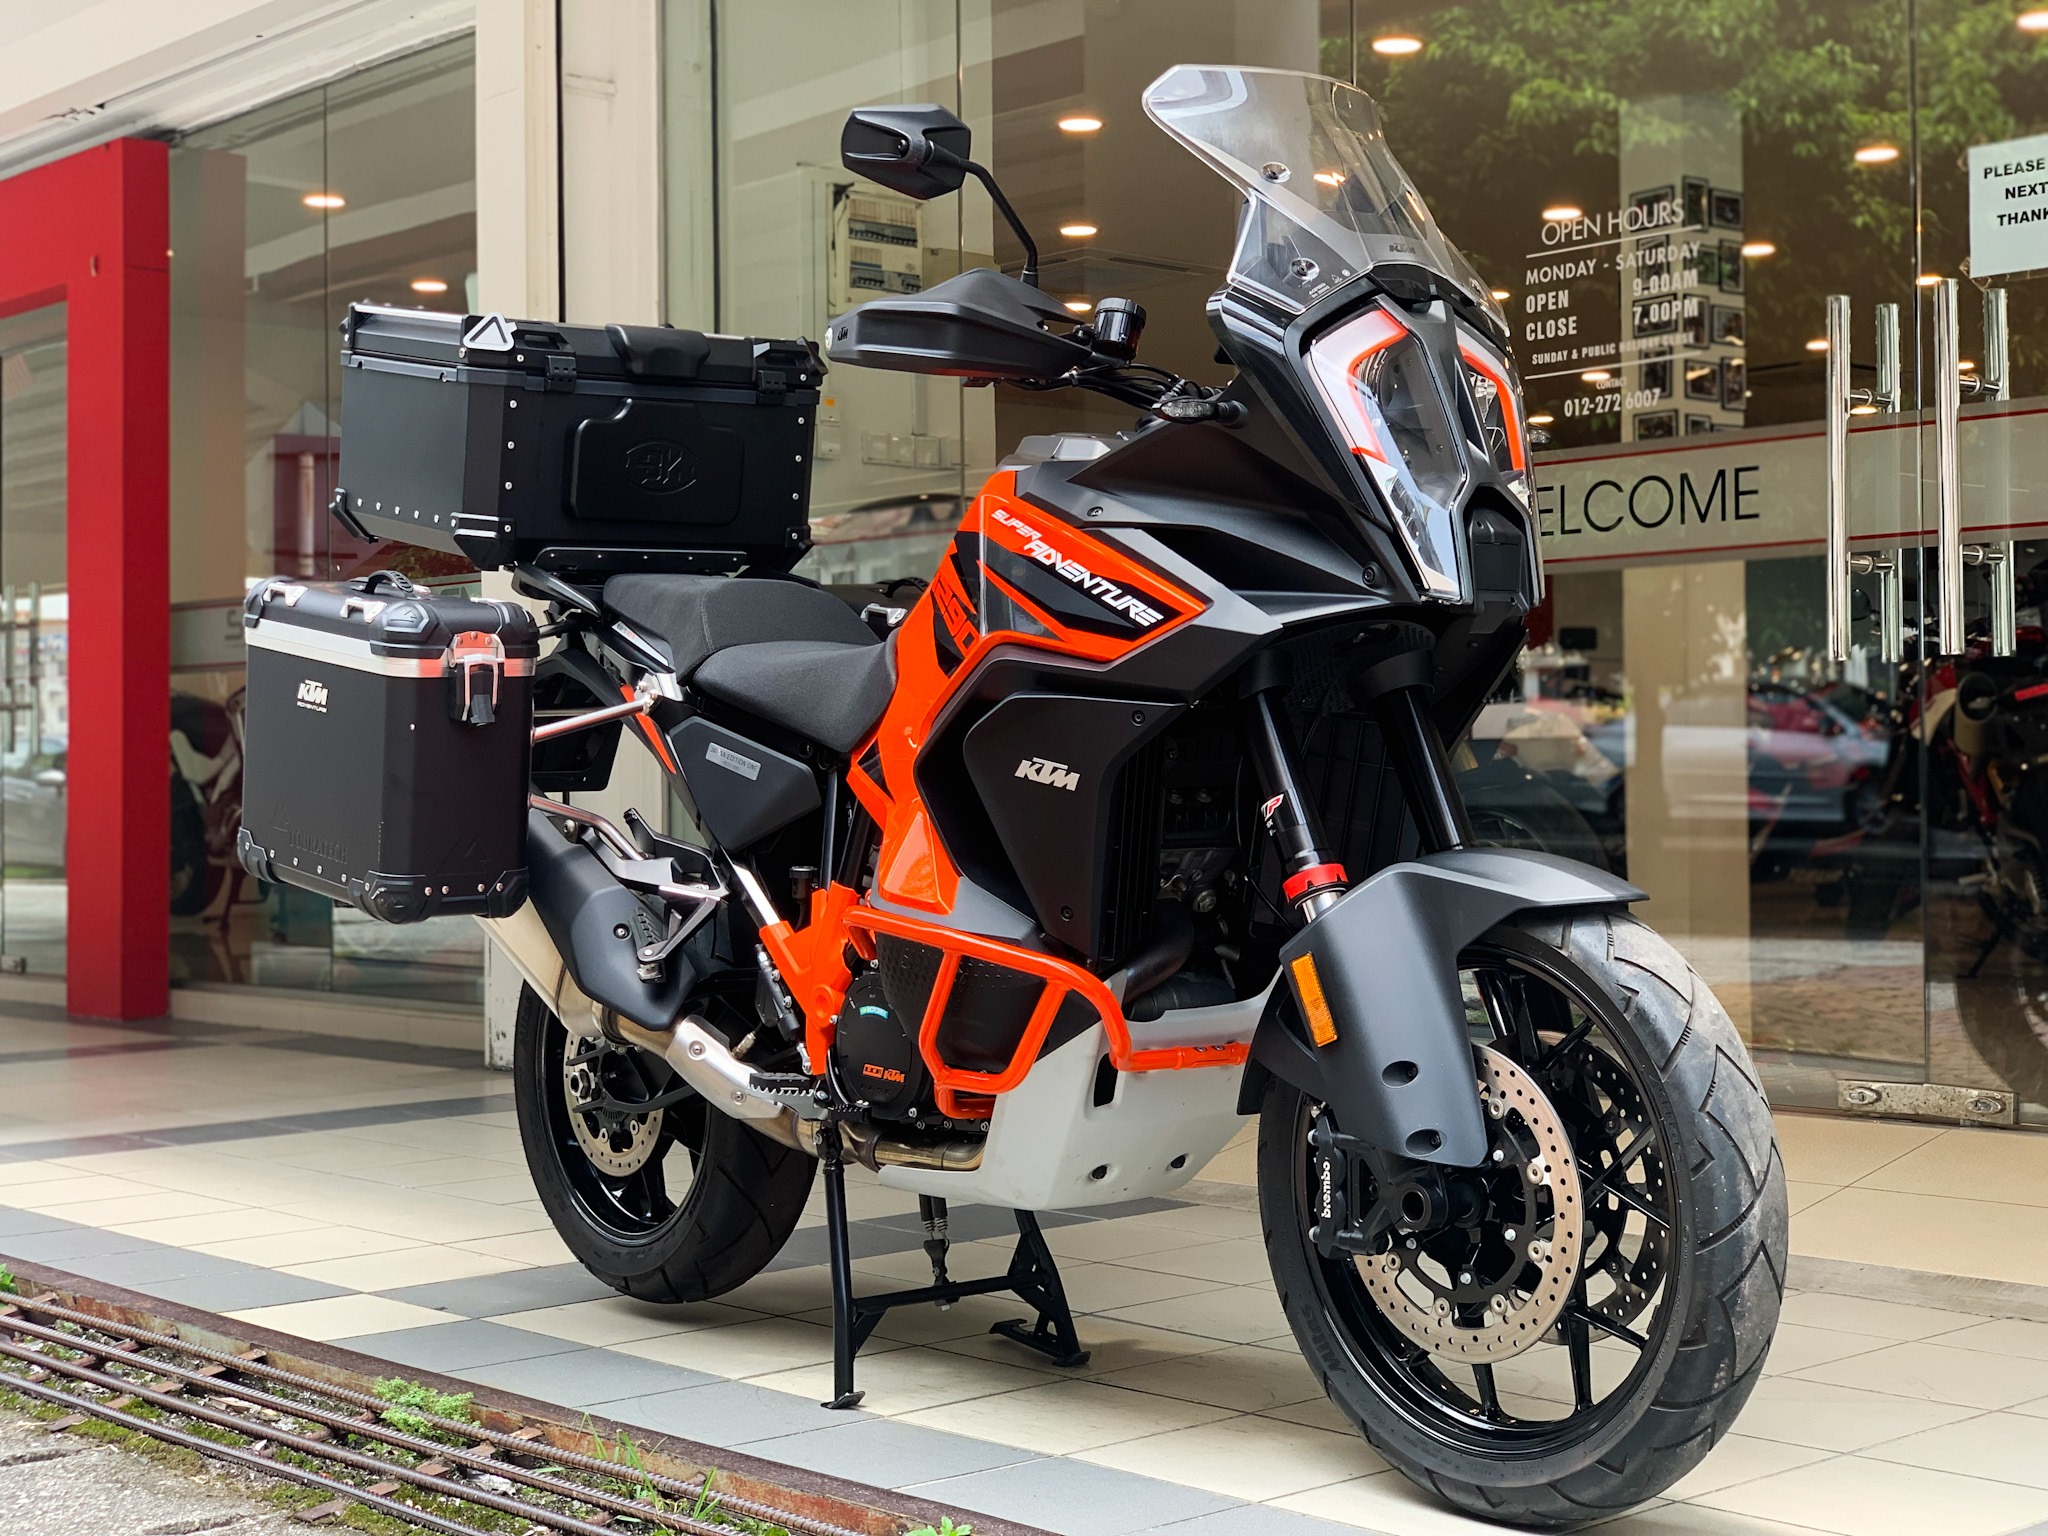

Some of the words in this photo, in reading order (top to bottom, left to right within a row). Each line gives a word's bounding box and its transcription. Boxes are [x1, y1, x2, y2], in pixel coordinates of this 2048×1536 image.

[1983, 157, 2046, 179] PLEASE
[1541, 213, 1601, 246] OPEN
[1608, 198, 1686, 234] HOURS
[1525, 258, 1597, 286] MONDAY
[1615, 241, 1701, 271] SATURDAY
[1525, 289, 1570, 314] OPEN
[1632, 269, 1699, 297] 9.00AM
[1525, 316, 1578, 342] CLOSE
[1632, 299, 1699, 326] 7.00PM
[1531, 348, 1569, 366] SUNDAY
[1571, 345, 1578, 360] &
[1581, 343, 1616, 359] PUBLIC
[1563, 393, 1621, 418] 012-272
[1625, 387, 1661, 410] 6007
[1536, 465, 1760, 537] ELCOME
[991, 508, 1043, 541] SUPER
[1023, 539, 1165, 628] ADVENTURE
[296, 679, 329, 706] KTM
[1014, 756, 1081, 792] KTM
[883, 1068, 906, 1083] KTM
[1320, 1160, 1332, 1219] brembo
